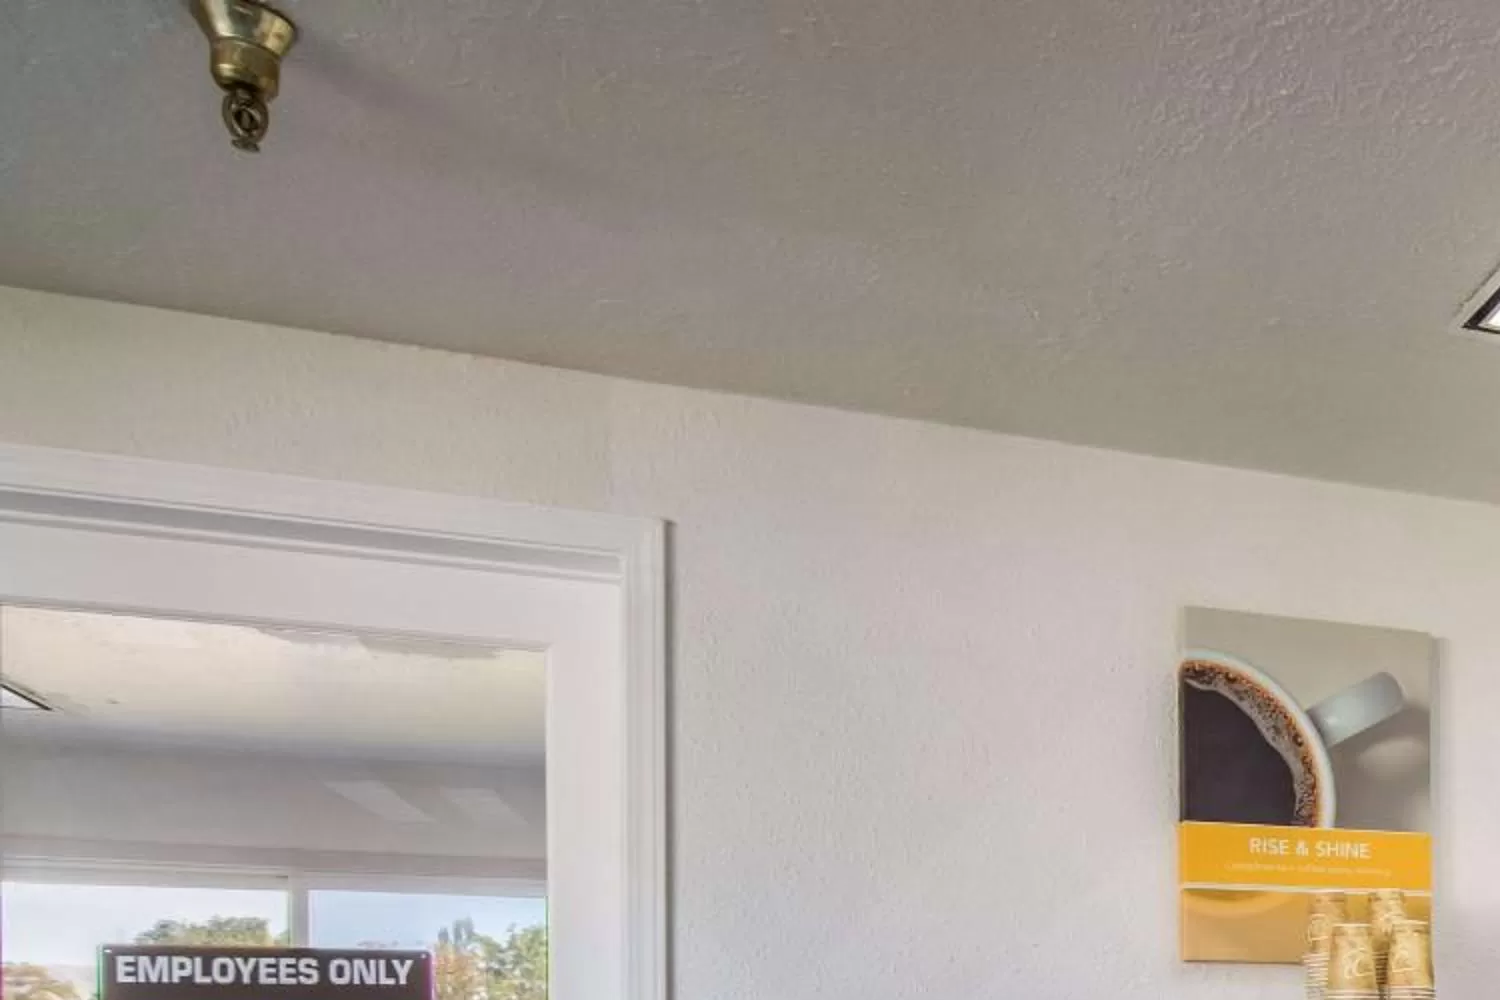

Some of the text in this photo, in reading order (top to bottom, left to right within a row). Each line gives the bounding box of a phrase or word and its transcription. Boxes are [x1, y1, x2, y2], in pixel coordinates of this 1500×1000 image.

[1248, 837, 1372, 859] RISE & SHINE
[115, 955, 413, 986] EMPLOYEES ONLY
